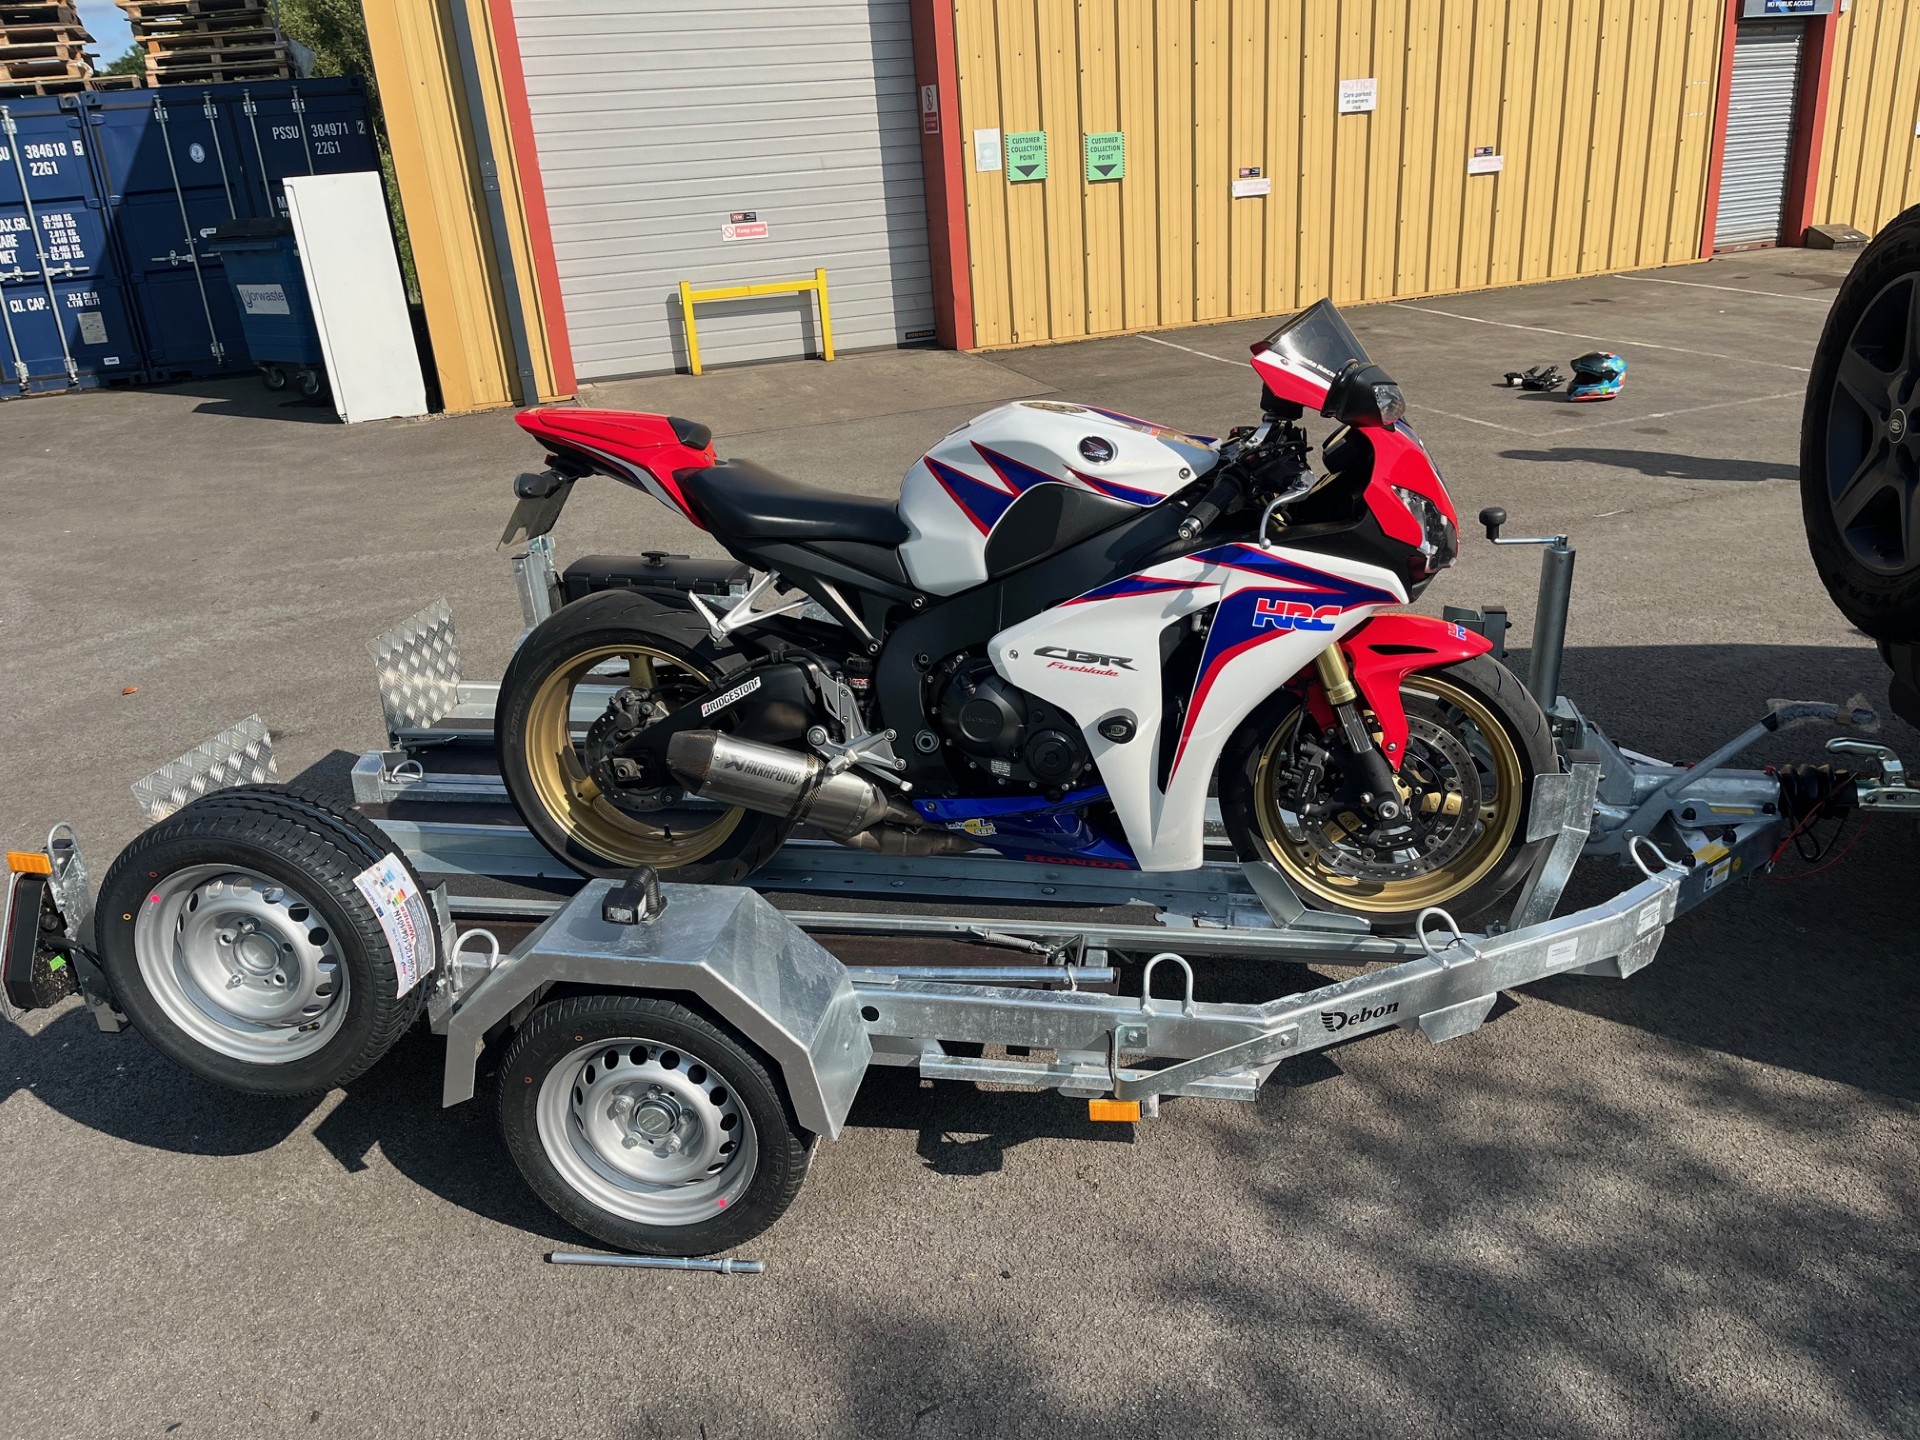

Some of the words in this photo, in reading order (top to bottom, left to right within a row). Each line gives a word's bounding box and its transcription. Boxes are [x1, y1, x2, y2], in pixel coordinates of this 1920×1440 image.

[272, 125, 299, 140] PSSU
[311, 122, 349, 138] 384971
[357, 120, 365, 134] 2
[1012, 136, 1040, 145] CUSTOMER
[1091, 136, 1118, 145] CUSTOMER
[24, 142, 67, 159] 384618
[73, 140, 84, 155] 5
[315, 140, 341, 155] 22G1
[1011, 145, 1043, 153] COLLECTION
[1090, 145, 1120, 153] COLLECTION
[1019, 153, 1036, 161] POINT
[1098, 153, 1114, 161] POINT
[29, 161, 59, 176] 22G1
[63, 213, 72, 221] KG
[65, 220, 77, 228] LBS
[67, 228, 77, 236] KG
[69, 235, 81, 243] LBS
[0, 249, 17, 264] NET
[73, 250, 85, 259] LBS
[9, 299, 27, 313] CU.
[27, 297, 50, 311] CAP.
[1252, 597, 1343, 632] HRC
[1033, 646, 1139, 671] CBR
[1046, 661, 1119, 677] Fireblade
[1023, 854, 1131, 871] HONDA
[1321, 1002, 1399, 1032] Debon
